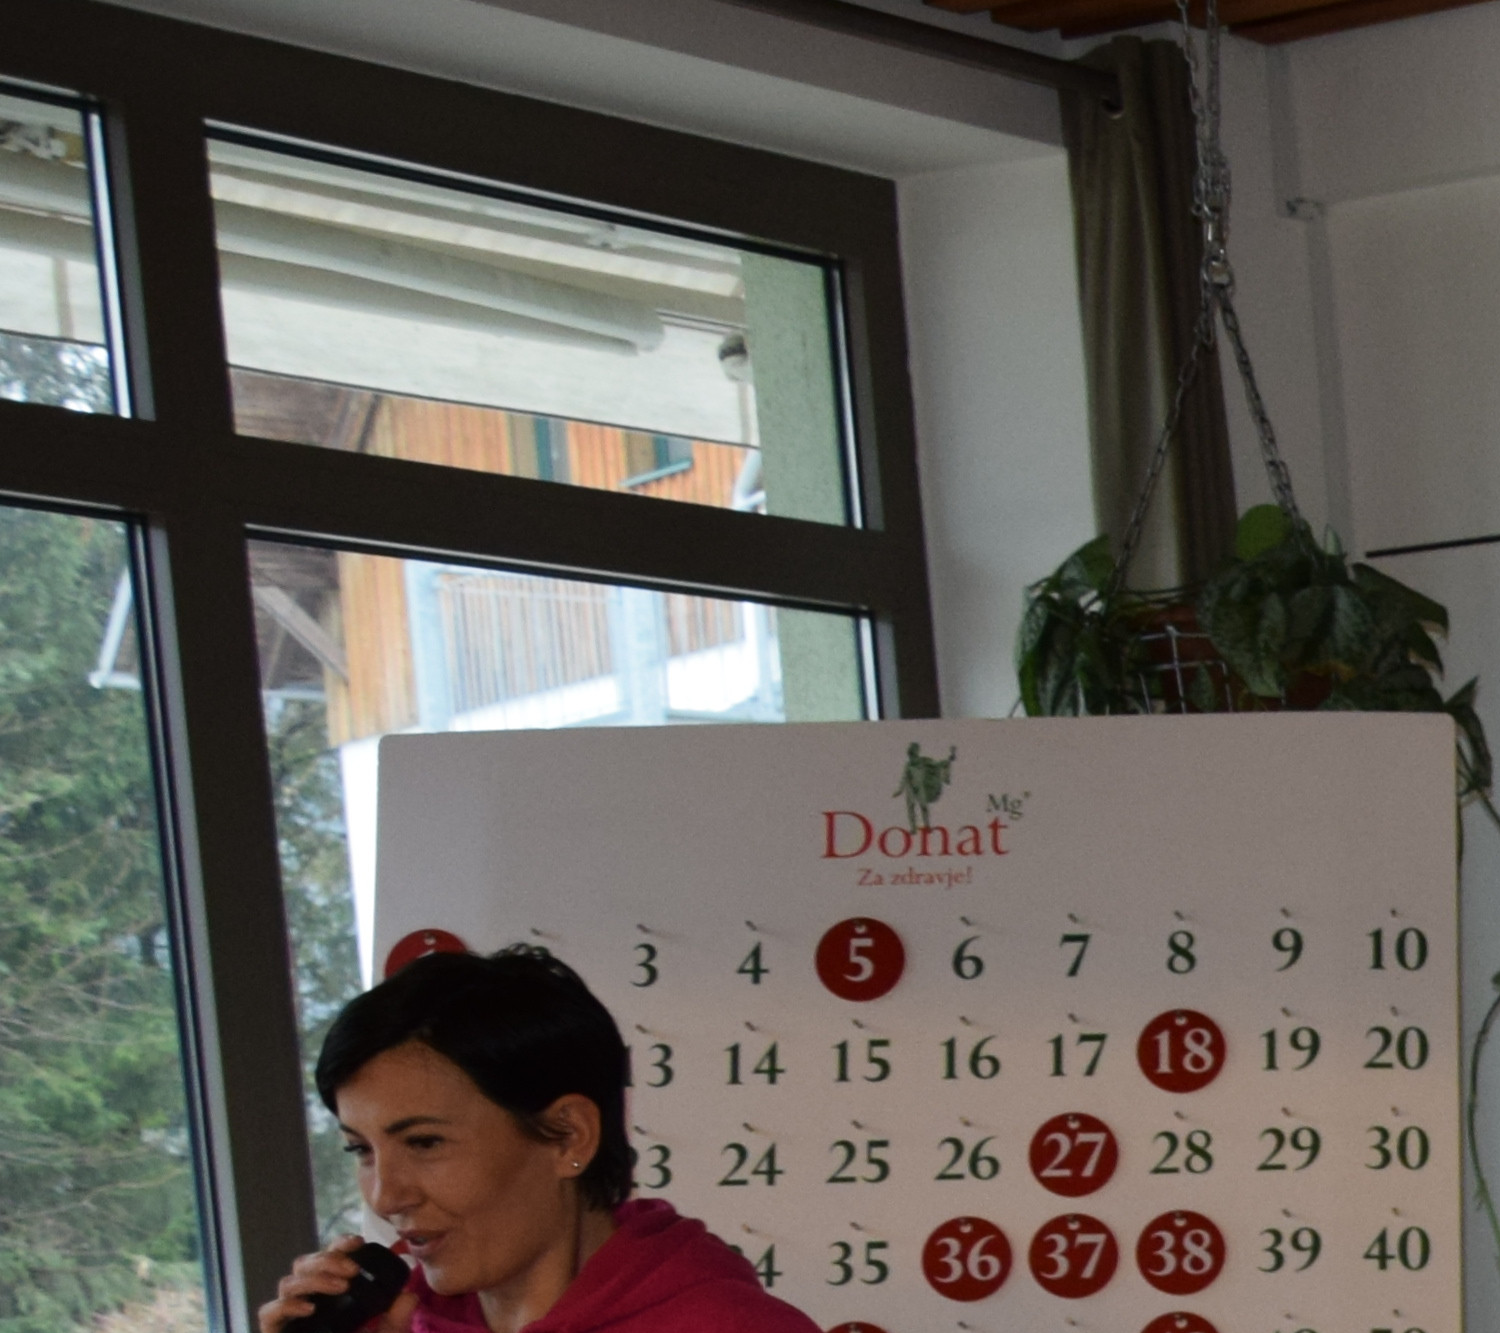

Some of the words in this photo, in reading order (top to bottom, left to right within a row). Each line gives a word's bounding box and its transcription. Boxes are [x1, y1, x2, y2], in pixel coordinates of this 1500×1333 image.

[821, 811, 1010, 859] Donat
[857, 867, 884, 887] Za
[890, 865, 974, 890] zdravje!
[630, 943, 659, 988] 3
[736, 941, 770, 985] 4
[845, 937, 875, 982] 5
[951, 936, 984, 980] 6
[1060, 933, 1091, 978] 7
[1166, 930, 1197, 975] 8
[1271, 927, 1304, 971] 9
[1366, 927, 1429, 972] 10
[726, 1042, 786, 1086] 14
[832, 1038, 891, 1083] 15
[942, 1035, 1001, 1080] 16
[1049, 1032, 1108, 1077] 17
[1152, 1027, 1215, 1074] 18
[1259, 1026, 1322, 1071] 19
[1363, 1025, 1430, 1070] 20
[717, 1142, 784, 1187] 24
[826, 1139, 891, 1184] 25
[934, 1136, 1001, 1181] 26
[1038, 1130, 1107, 1178] 27
[1149, 1129, 1214, 1175] 28
[1256, 1126, 1322, 1172] 29
[1366, 1125, 1430, 1171] 30
[827, 1240, 890, 1287] 35
[936, 1234, 1001, 1283] 36
[1041, 1233, 1107, 1280] 37
[1147, 1227, 1214, 1277] 38
[1258, 1227, 1322, 1273] 39
[1362, 1226, 1431, 1271] 40
